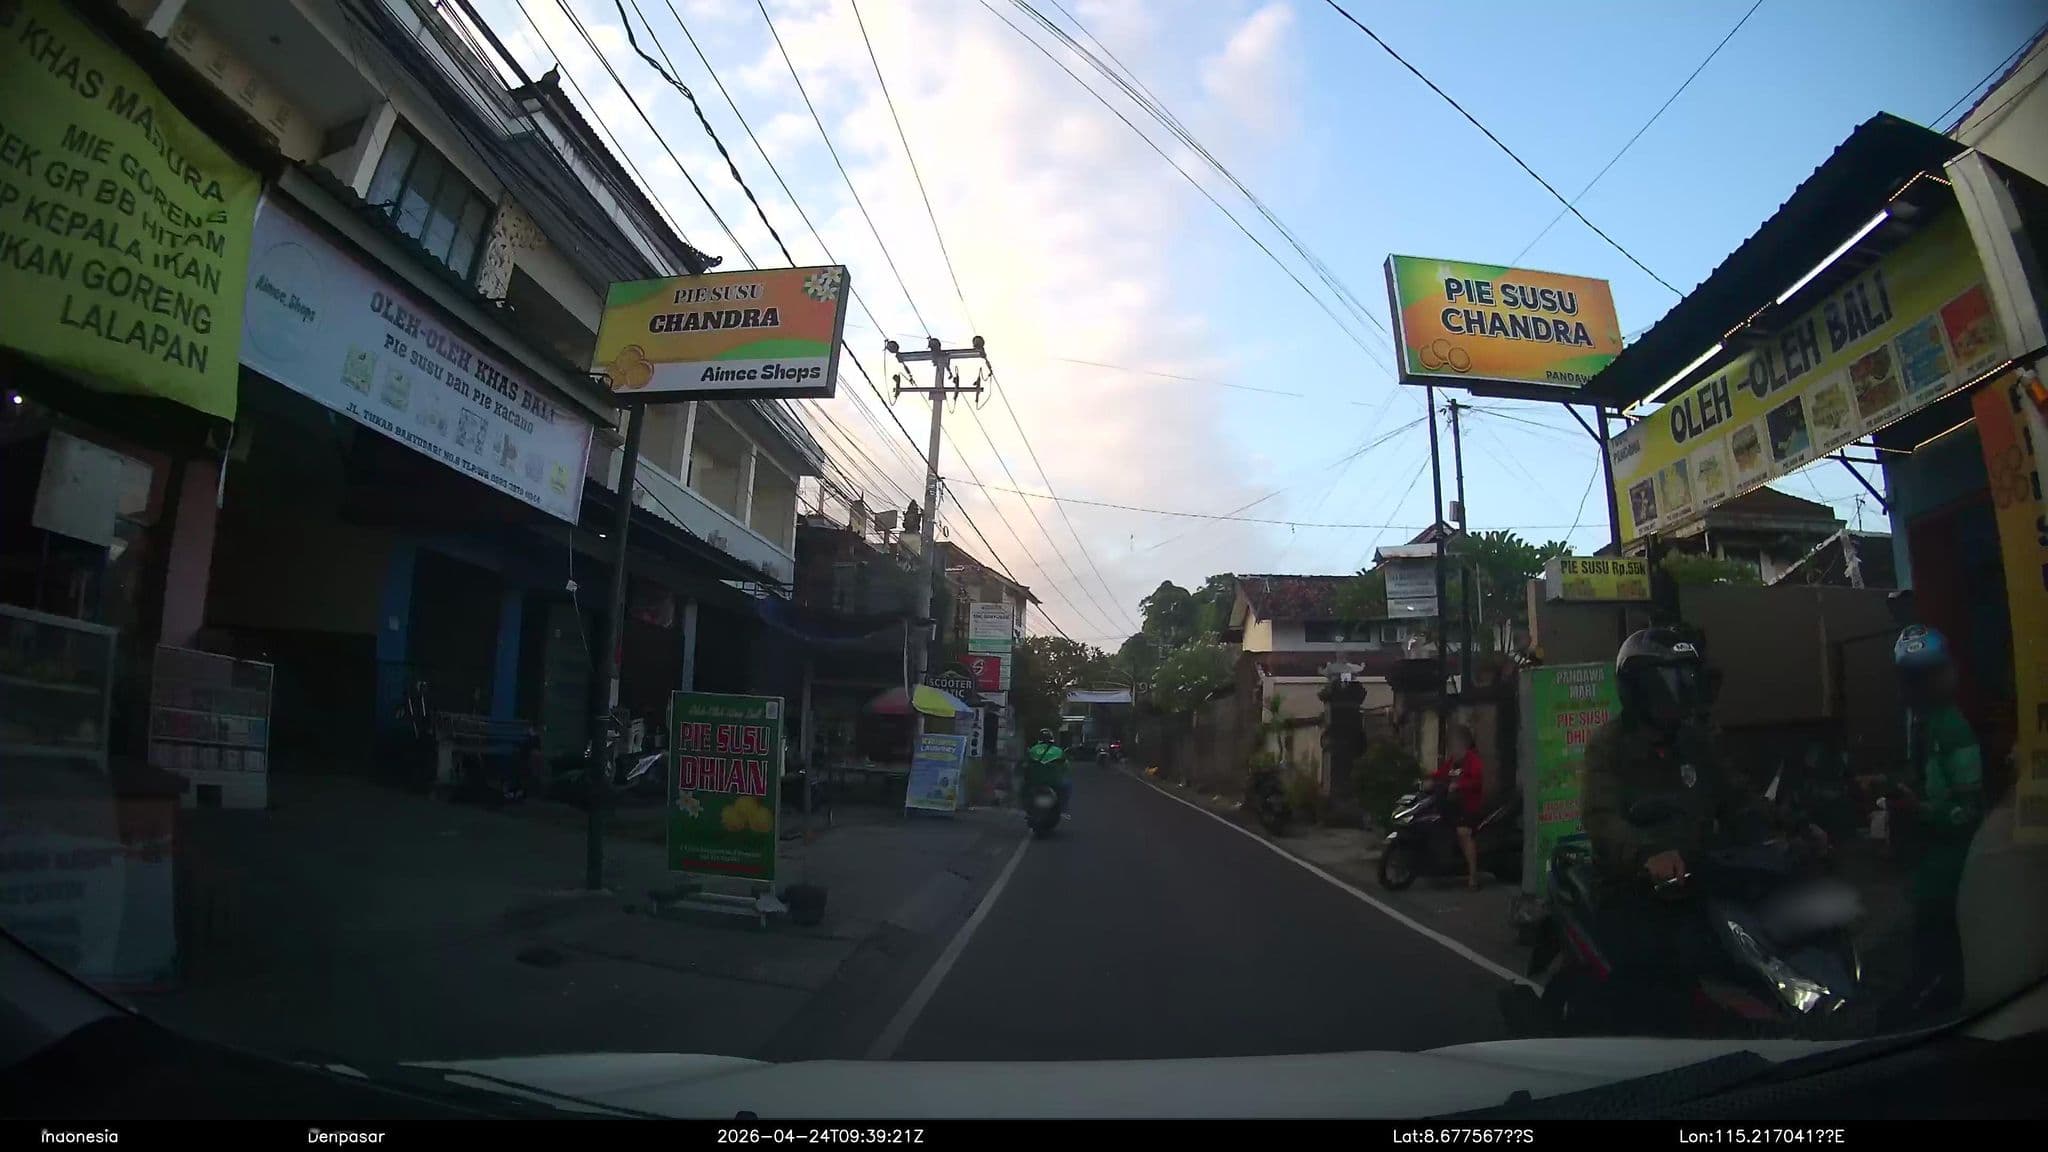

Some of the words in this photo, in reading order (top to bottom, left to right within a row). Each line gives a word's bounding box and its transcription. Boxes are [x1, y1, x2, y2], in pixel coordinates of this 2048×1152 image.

[18, 17, 104, 98] KHAS
[61, 123, 115, 165] MIE
[119, 153, 228, 227] GORENG
[44, 160, 90, 198] GR
[95, 178, 135, 216] BB
[142, 210, 226, 258] HITAM
[22, 194, 143, 264] KEPALA
[152, 252, 221, 296] IKAN
[82, 259, 212, 335] GORENG
[673, 287, 710, 305] PIE
[711, 282, 763, 302] SUSU
[1444, 277, 1497, 306] PIE
[1500, 282, 1578, 316] SUSU
[60, 294, 208, 374] LALAPAN
[649, 306, 780, 334] CHANDRA
[1440, 306, 1595, 349] CHANDRA
[370, 291, 473, 374] OLEH-OLEH
[474, 358, 519, 402] KHAS
[521, 390, 557, 425] BALI
[701, 364, 758, 383] Aimee
[760, 363, 821, 383] Shops
[1669, 375, 1733, 444] OLEH
[1827, 269, 1893, 353] BALI
[1546, 370, 1592, 384] PANDAW
[1560, 560, 1578, 574] PIE
[1581, 560, 1609, 575] SUSU
[929, 678, 972, 690] SCOOTER
[1556, 668, 1604, 684] PANDAWA
[1569, 683, 1598, 699] MART
[679, 722, 712, 751] PIE
[716, 724, 770, 756] SUSU
[1557, 712, 1575, 728] PIE
[679, 755, 768, 796] DHIAN
